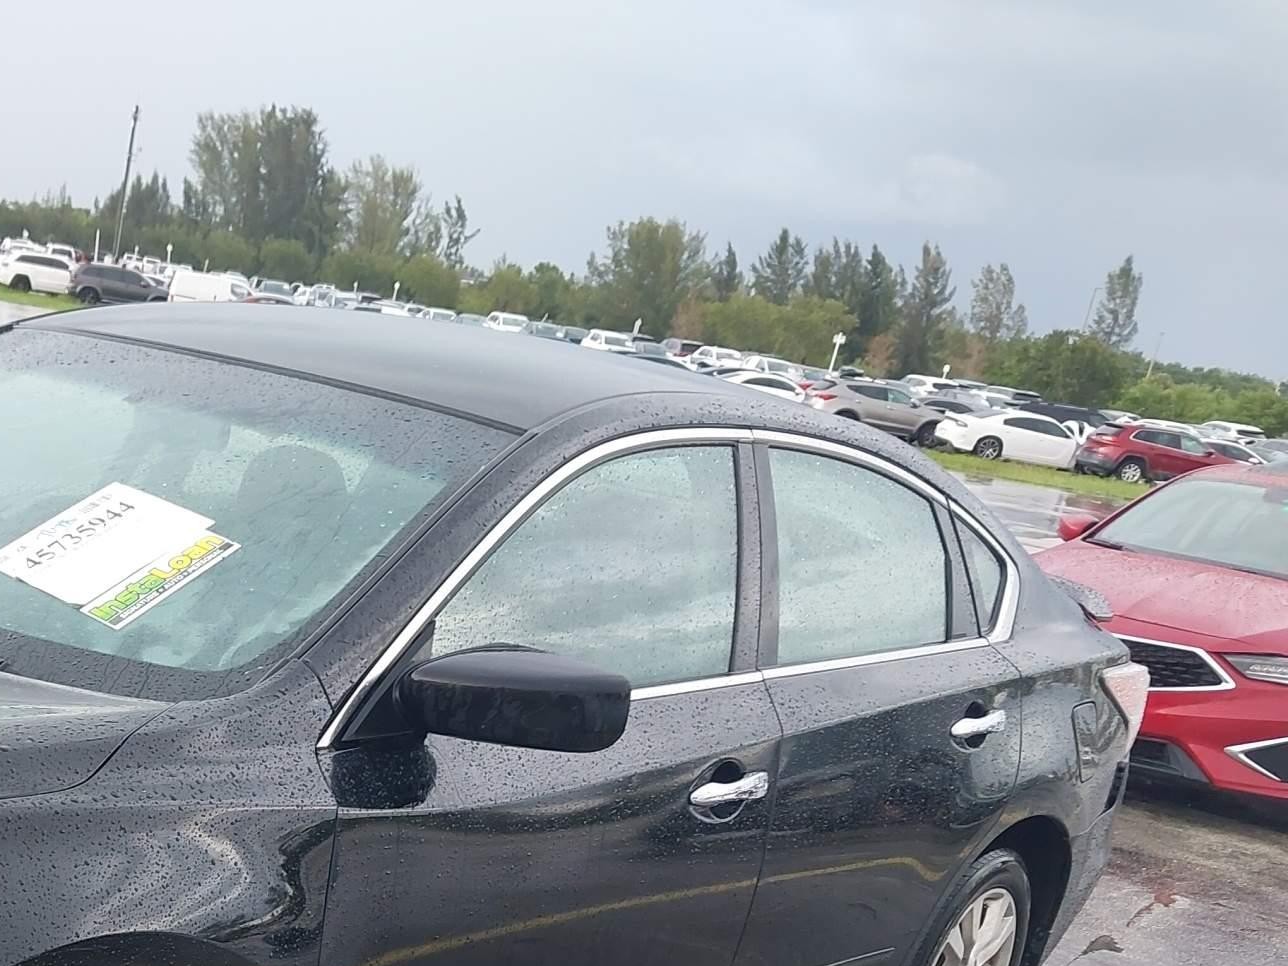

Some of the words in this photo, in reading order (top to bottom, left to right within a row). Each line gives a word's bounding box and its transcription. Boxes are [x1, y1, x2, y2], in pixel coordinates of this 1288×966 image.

[26, 501, 135, 569] 45735944
[88, 535, 226, 621] InstaLoan
[163, 575, 185, 590] AUTO
